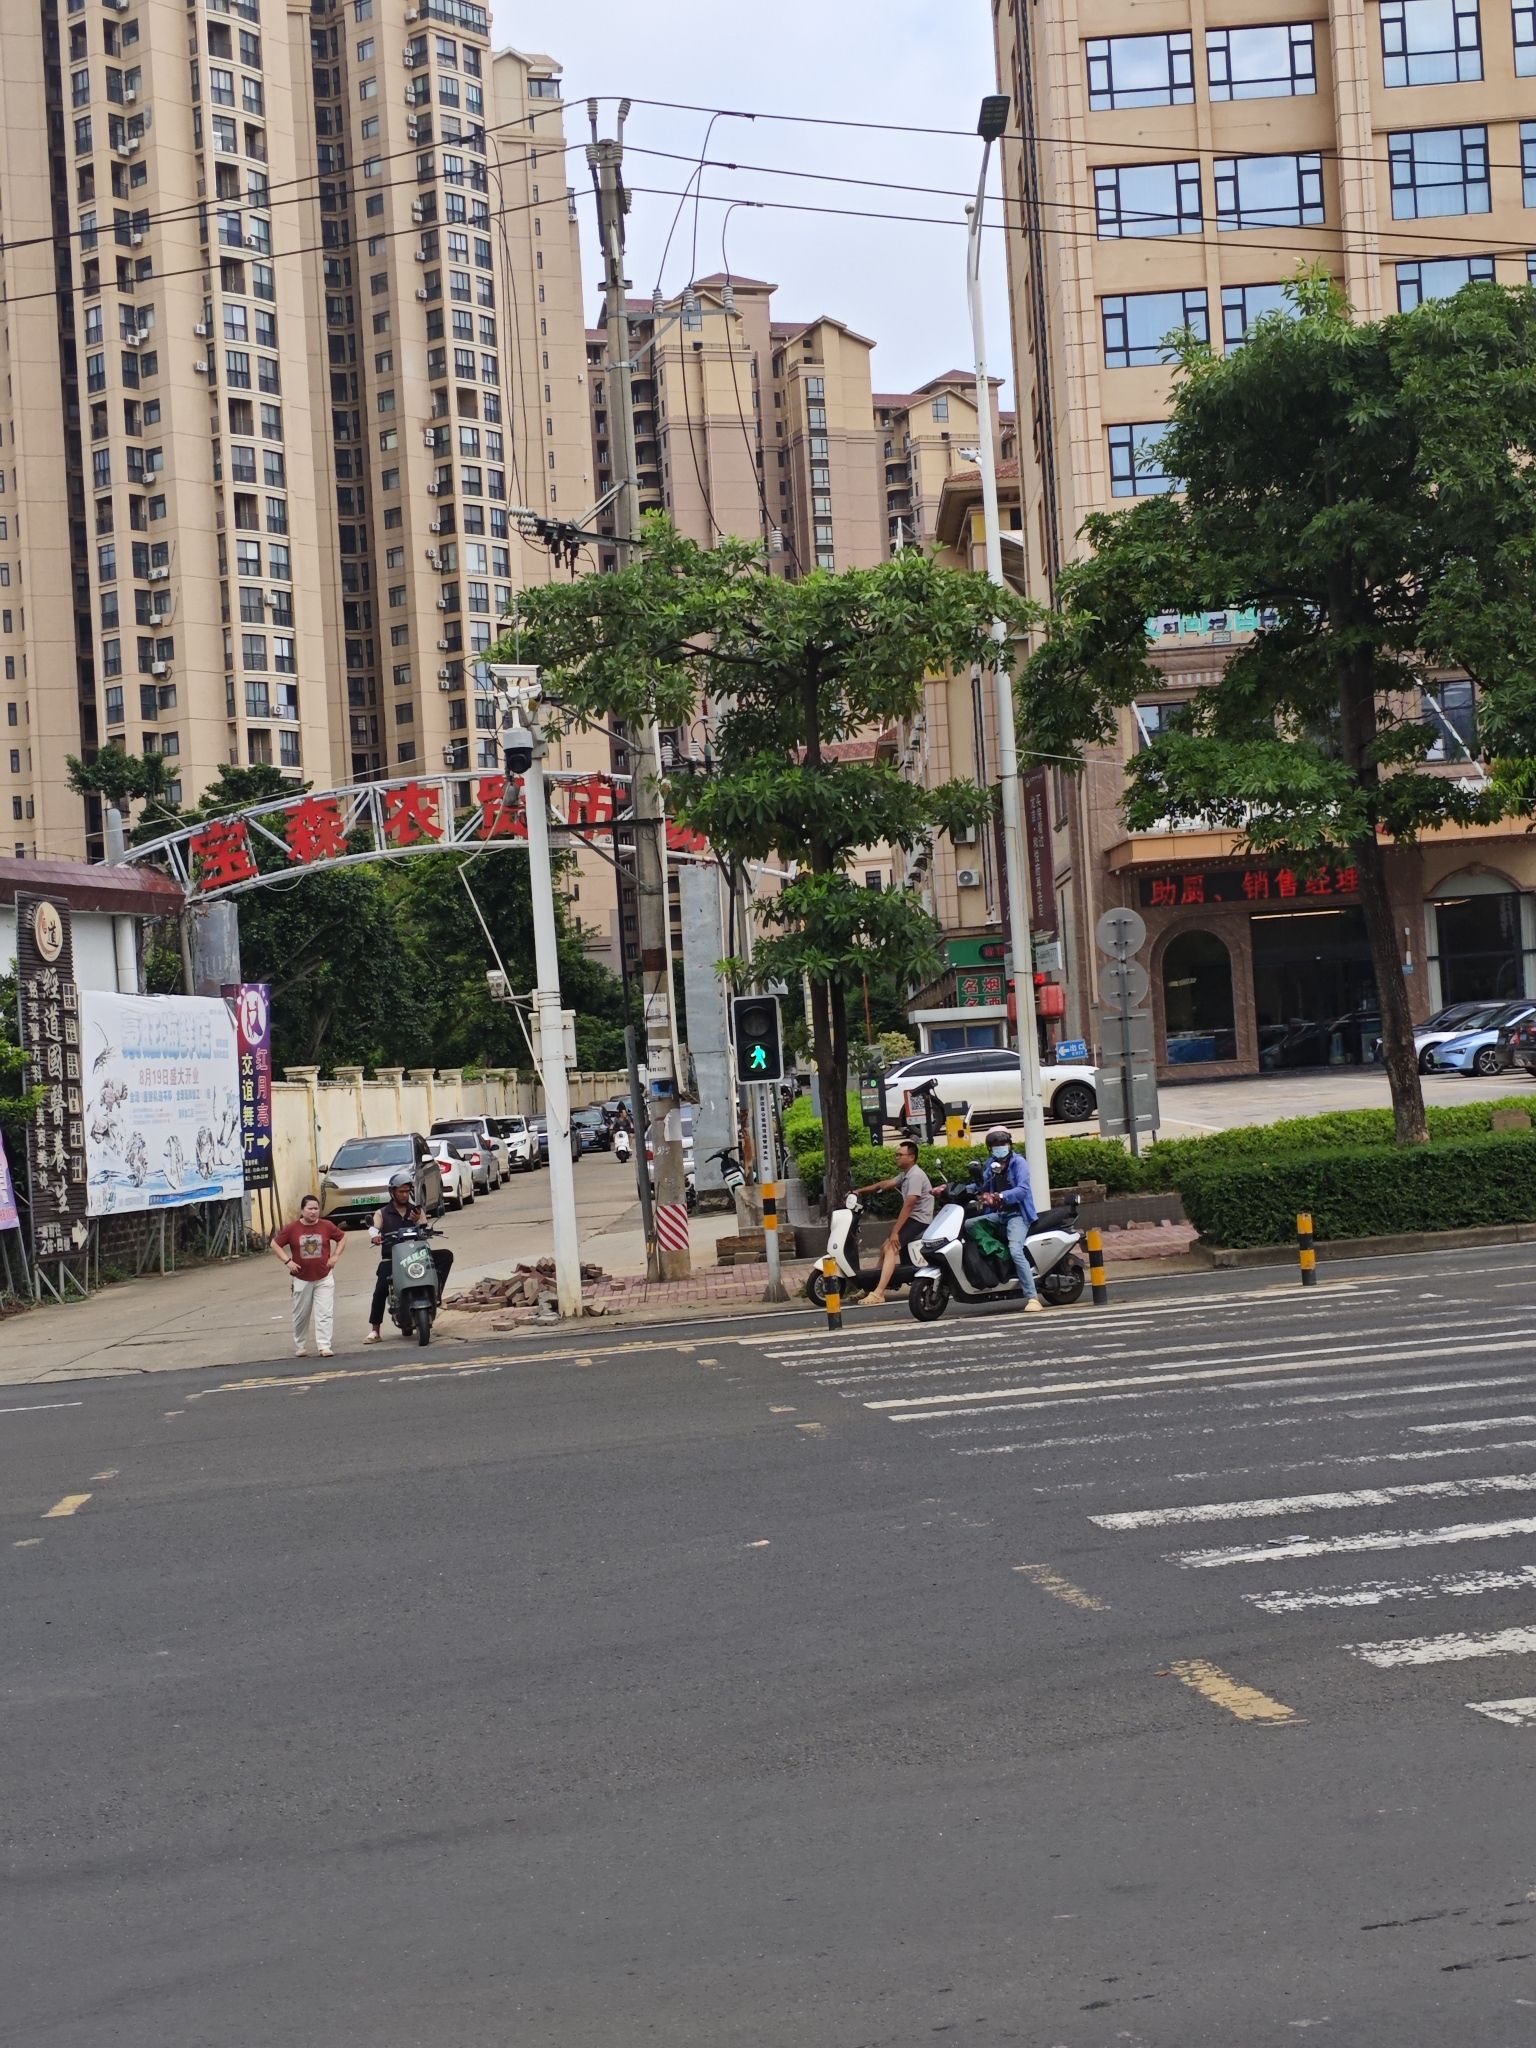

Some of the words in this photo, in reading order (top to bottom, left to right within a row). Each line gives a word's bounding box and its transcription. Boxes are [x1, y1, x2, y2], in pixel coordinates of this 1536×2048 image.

[139, 1067, 200, 1087] 8月19日盛大开业
[255, 1048, 270, 1128] 红月亮
[241, 1053, 255, 1154] 交谊舞厅
[400, 1249, 428, 1268] TAILG
